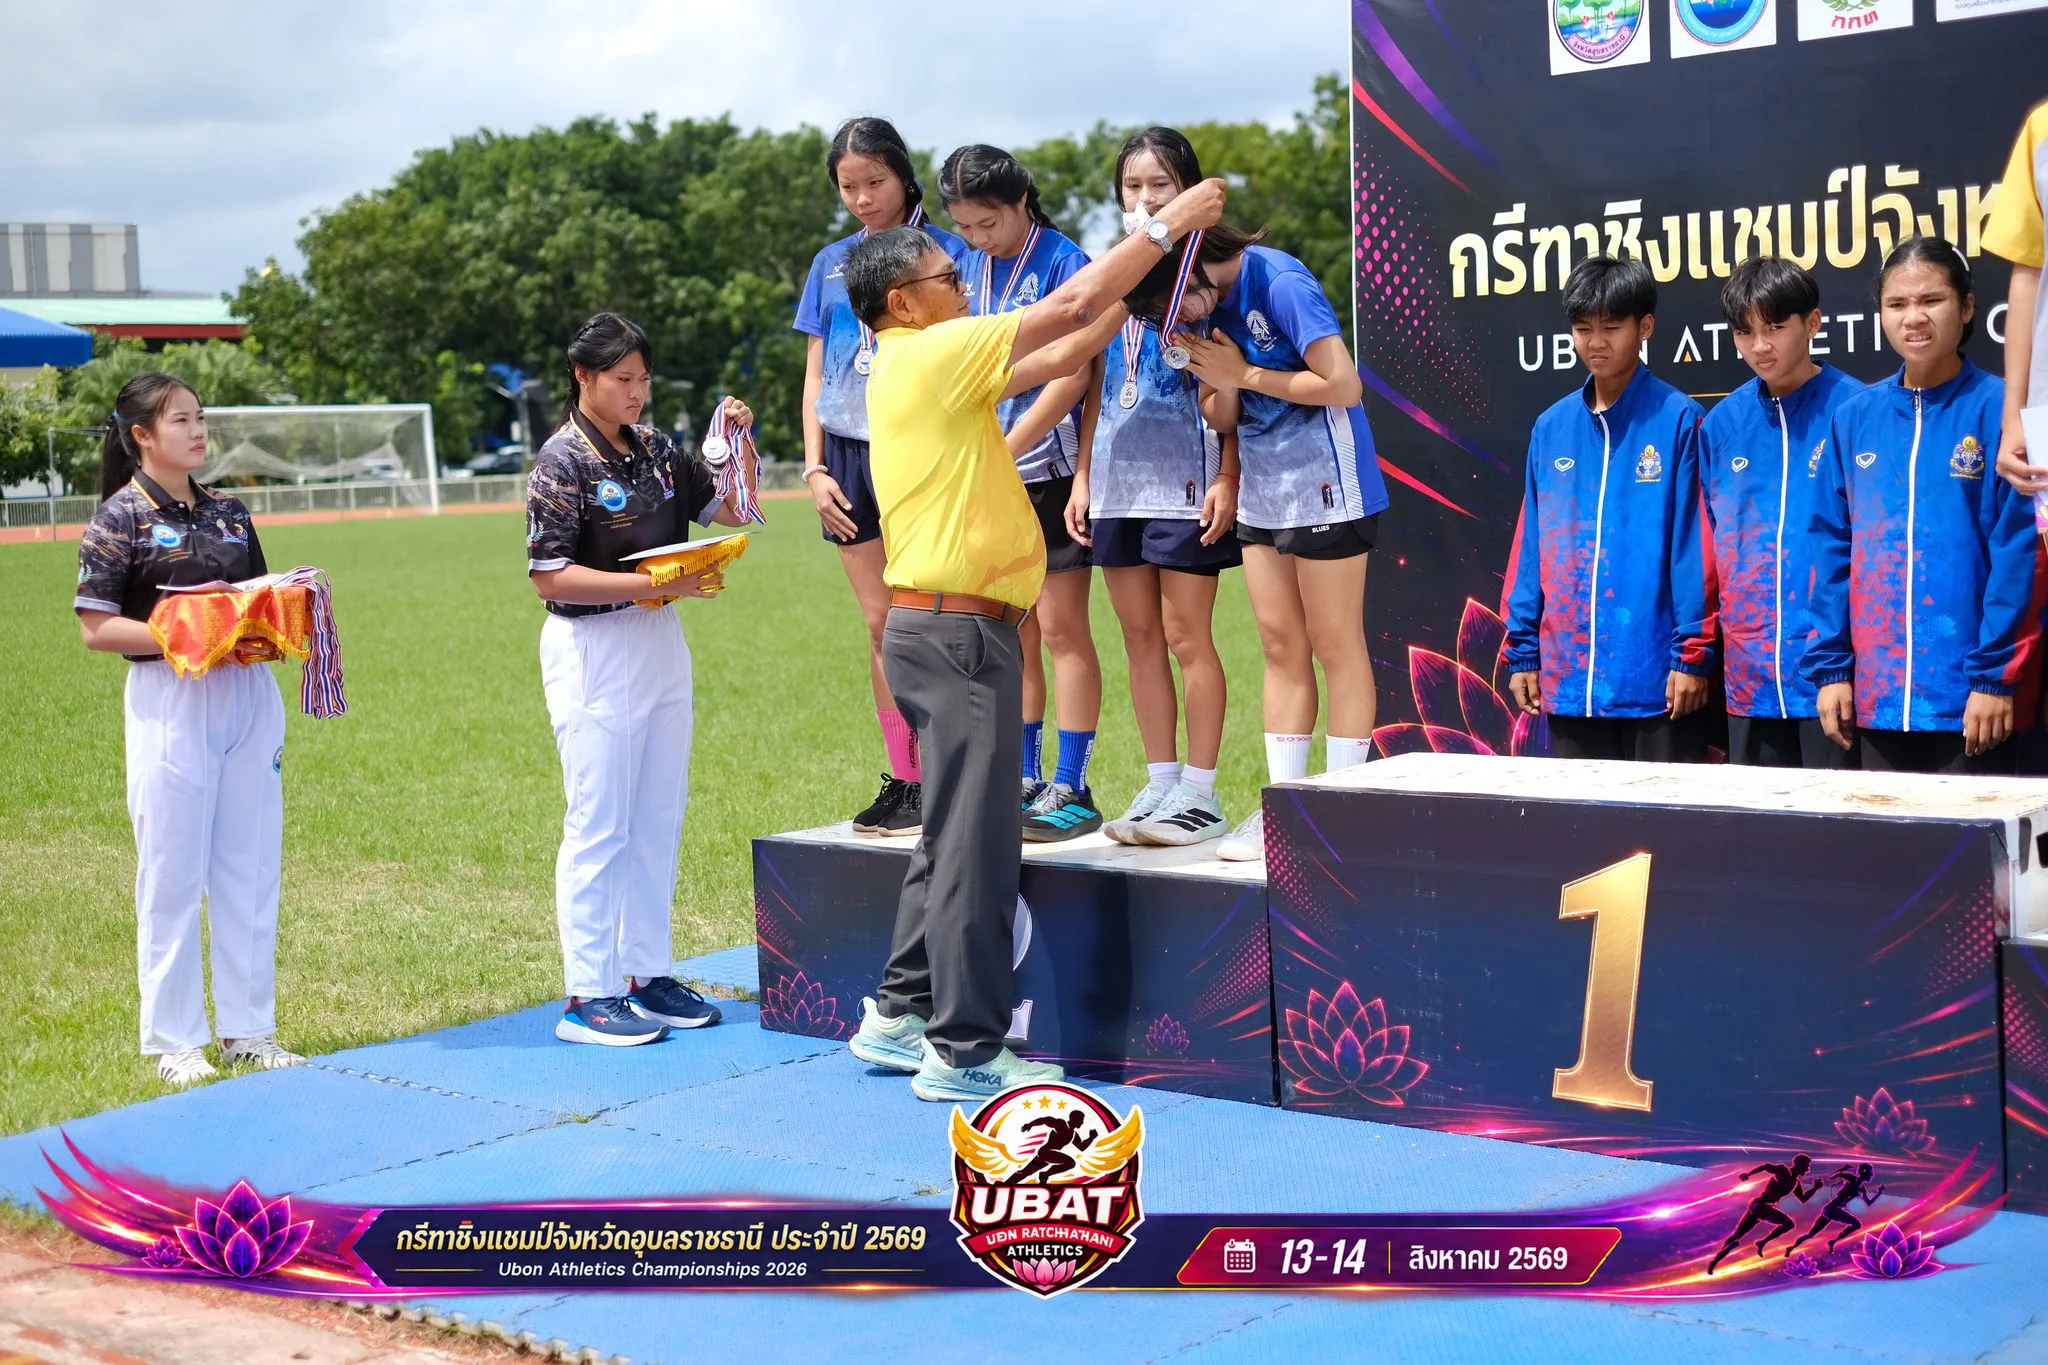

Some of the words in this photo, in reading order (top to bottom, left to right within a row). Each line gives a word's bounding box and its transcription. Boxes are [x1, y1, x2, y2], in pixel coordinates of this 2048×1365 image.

[1518, 333, 1649, 372] UBN
[1553, 853, 1653, 1112] 1
[961, 1069, 1002, 1086] HOKA
